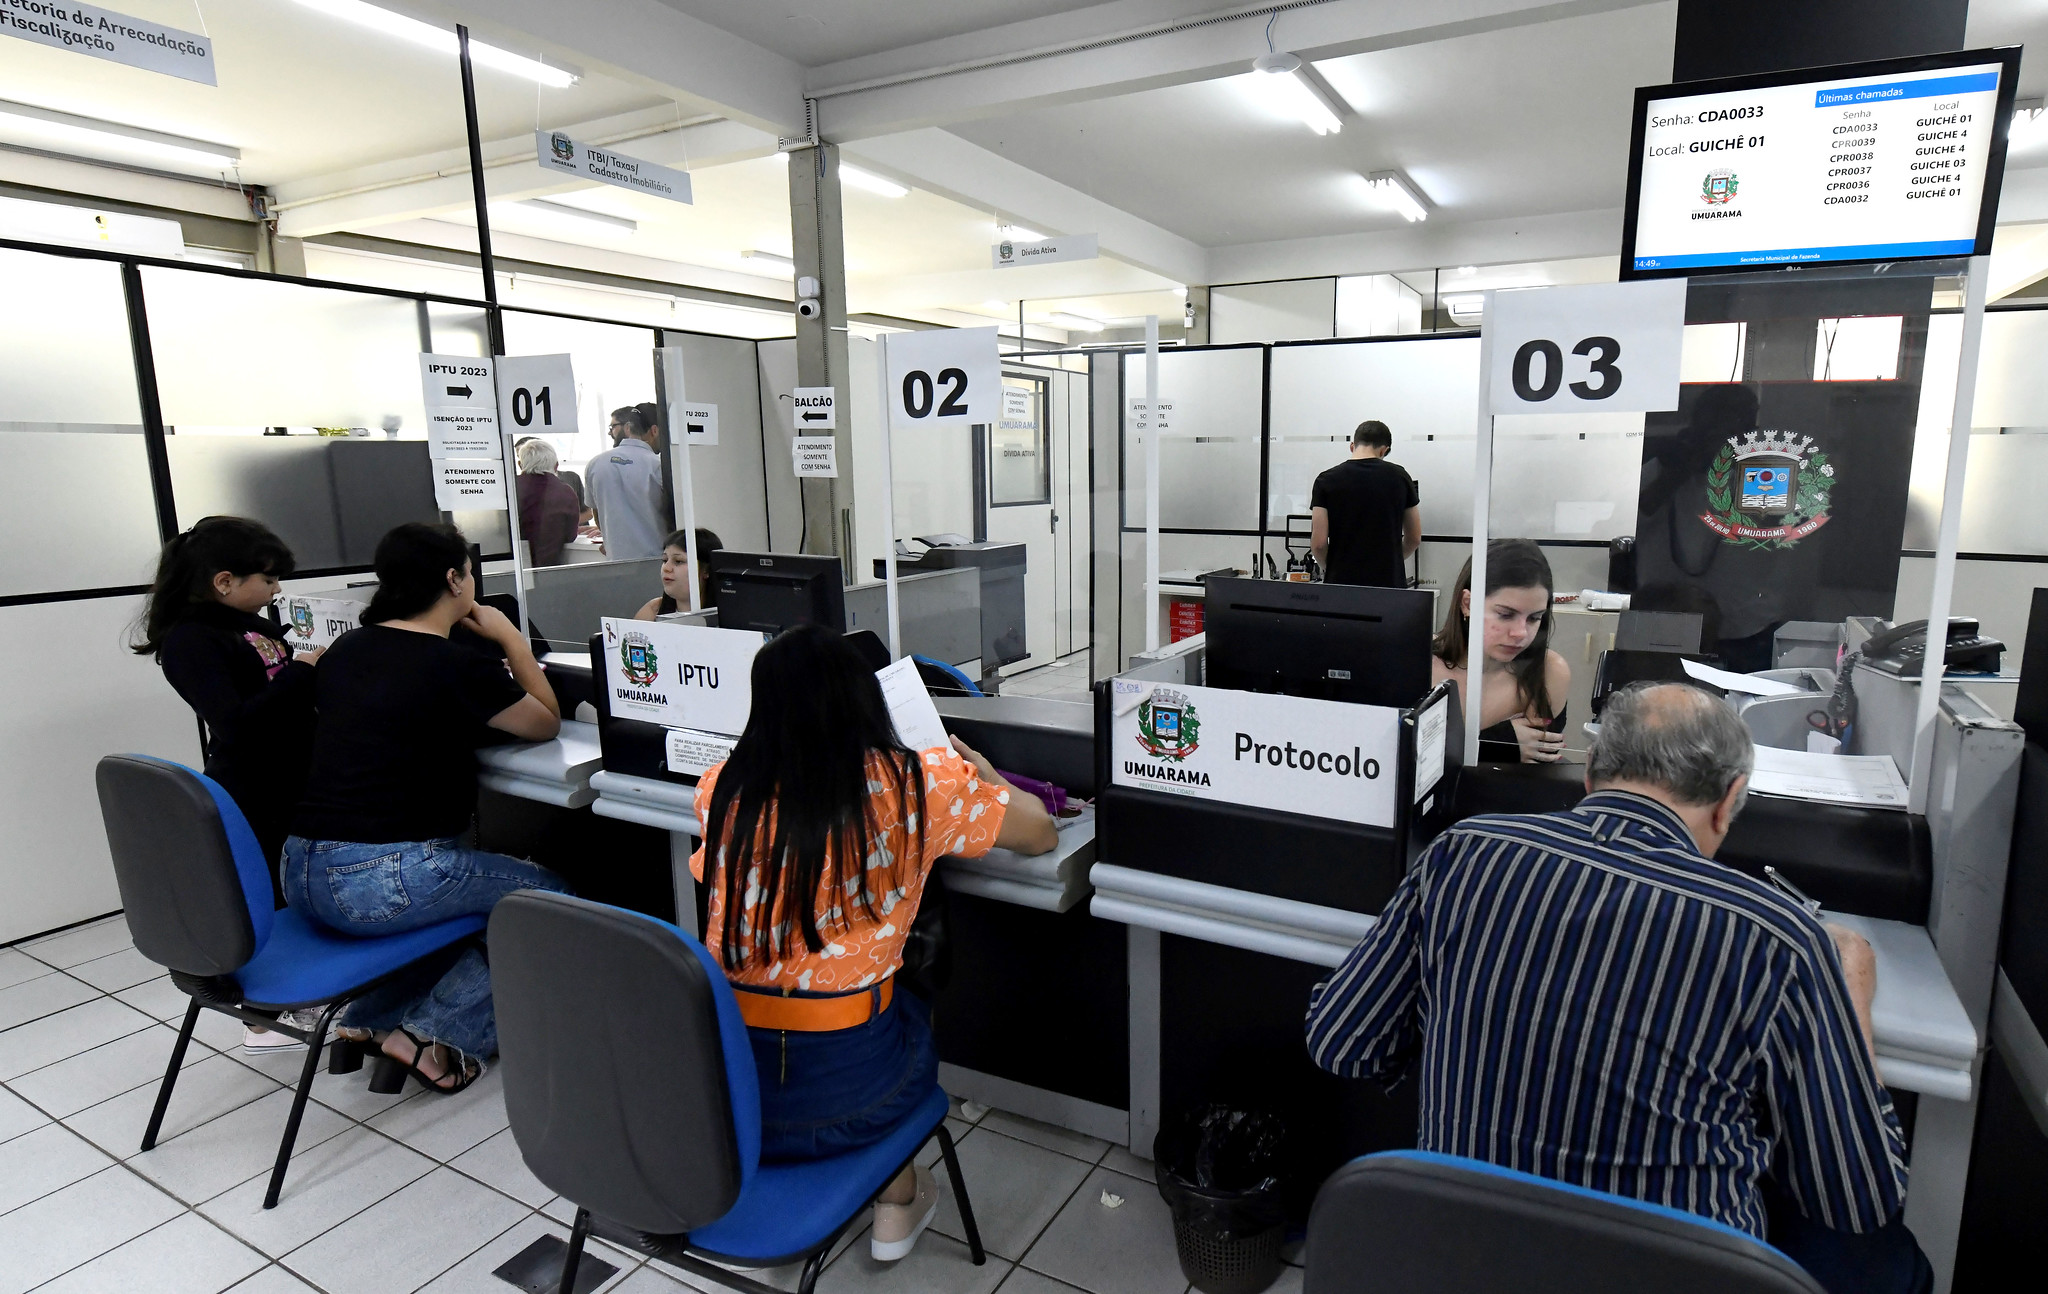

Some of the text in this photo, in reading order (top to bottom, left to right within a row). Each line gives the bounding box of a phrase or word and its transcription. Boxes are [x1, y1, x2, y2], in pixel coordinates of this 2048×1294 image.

[0, 9, 115, 52] Fiscalização
[72, 10, 94, 28] de
[98, 17, 206, 57] Arrecadação
[1819, 88, 1903, 104] Últimas chamadas
[1934, 101, 1959, 111] Local
[1652, 106, 1764, 128] Senha: CDA0033
[1843, 110, 1871, 119] Senha
[1916, 114, 1957, 127] GUICHÊ
[1833, 123, 1878, 134] CDA0033
[1918, 130, 1958, 141] GUICHE
[1650, 135, 1764, 157] Local: GUICHÊ 01
[1832, 138, 1875, 148] CPR0039
[1916, 145, 1955, 156] GUICHE
[588, 150, 638, 175] ITBI/ Taxas/
[1830, 152, 1874, 163] CPR0038
[1910, 160, 1950, 170] GUICHE
[1828, 167, 1872, 177] CPR0037
[589, 164, 671, 193] Cadastro Imobiliário
[1911, 174, 1951, 184] GUICHE
[1827, 181, 1870, 191] CPR0036
[1906, 188, 1946, 199] GUICHÊ
[1824, 195, 1868, 205] CDA0032
[1692, 210, 1742, 220] UMUARAMA
[429, 365, 487, 377] IPTU 2023
[1512, 336, 1623, 402] 03
[902, 368, 969, 419] 02
[512, 386, 552, 426] 01
[795, 396, 832, 407] BALCÃO
[1704, 515, 1710, 524] 25
[1715, 524, 1730, 534] JULHO
[1797, 522, 1817, 535] 1960
[1738, 527, 1785, 537] UMUARAMA
[678, 663, 718, 689] IPTU
[617, 688, 668, 705] UMUARAMA
[1235, 733, 1380, 780] Protocolo
[1125, 761, 1211, 786] UMUARAMA
[1139, 782, 1167, 791] PREFEITURA
